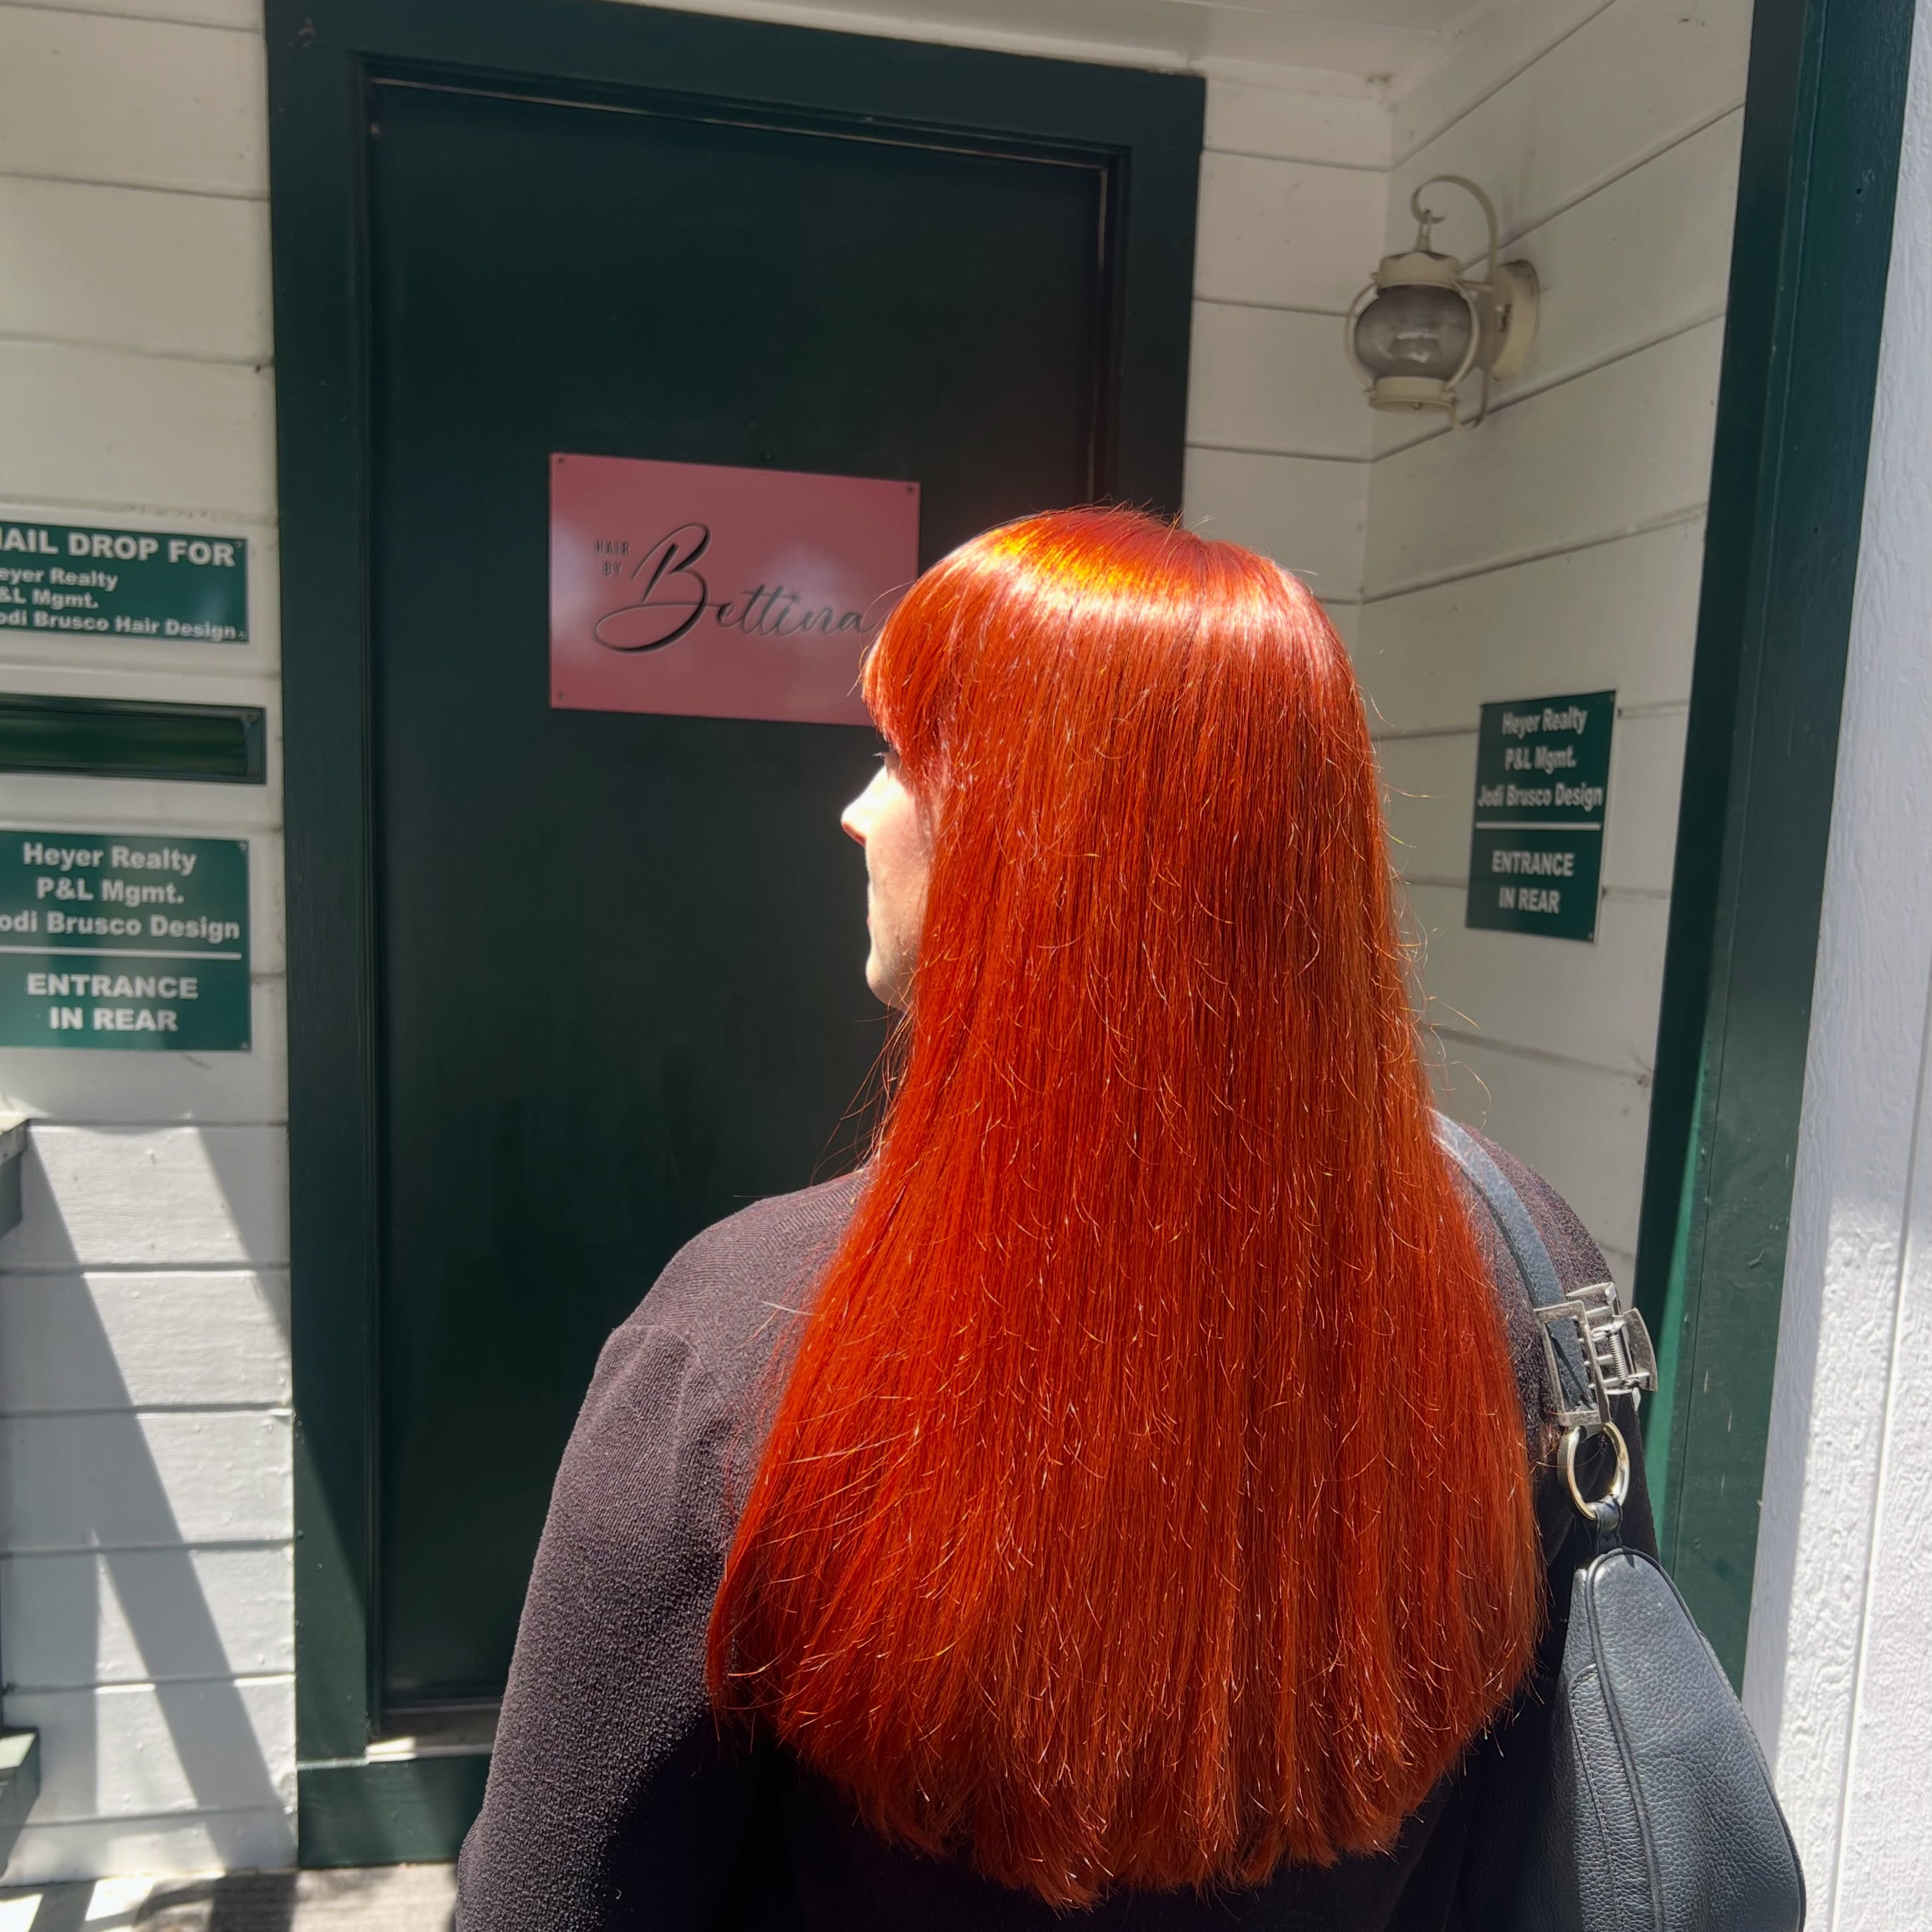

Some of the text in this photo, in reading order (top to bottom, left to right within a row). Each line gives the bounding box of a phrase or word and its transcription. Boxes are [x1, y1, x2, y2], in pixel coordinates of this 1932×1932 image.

[67, 532, 159, 562] DROP
[168, 538, 236, 567] FOR
[593, 538, 630, 556] HAIR
[49, 567, 118, 591] Realty
[601, 562, 622, 578] BY
[32, 588, 99, 610] Mgmt.
[594, 522, 880, 655] Bettina
[33, 611, 109, 631] Brusco
[114, 615, 160, 635] Hair
[164, 619, 237, 642] Design
[1501, 706, 1588, 739] Heyer Realty
[1504, 745, 1577, 775] P&L Mgmt.
[1477, 782, 1603, 813] Jodi Brusco Design
[23, 841, 197, 876] Heyer Realty
[1492, 850, 1574, 877] ENTRANCE
[37, 877, 185, 907] P&L Mgmt.
[1499, 887, 1560, 914] IN REAR
[47, 911, 142, 936] Brusco
[150, 914, 240, 944] Design
[27, 972, 199, 1000] ENTRANCE
[50, 1007, 179, 1031] IN REAR
